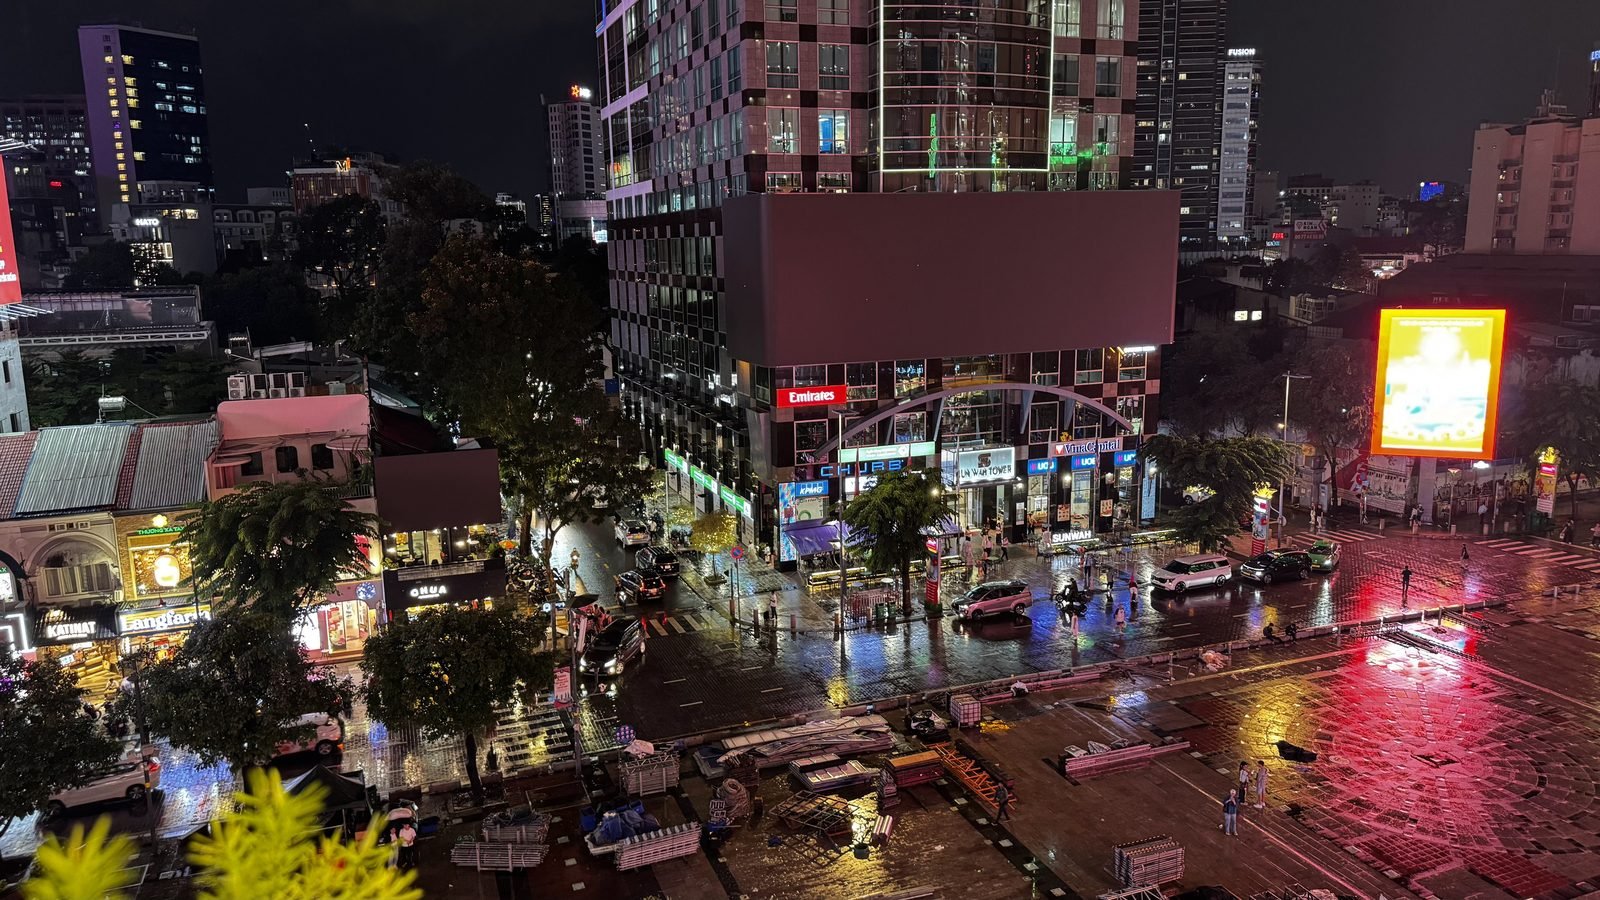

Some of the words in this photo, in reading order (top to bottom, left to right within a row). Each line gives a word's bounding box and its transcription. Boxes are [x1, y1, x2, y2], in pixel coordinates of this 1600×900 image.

[1227, 47, 1256, 57] FUSION
[788, 390, 835, 404] Emirates
[1063, 439, 1120, 455] VinaCapital
[820, 459, 903, 477] CHUBB
[988, 463, 1012, 475] TOWER
[799, 486, 824, 495] KPMG
[1052, 530, 1092, 543] SUNWAH
[46, 620, 97, 638] KATINAT
